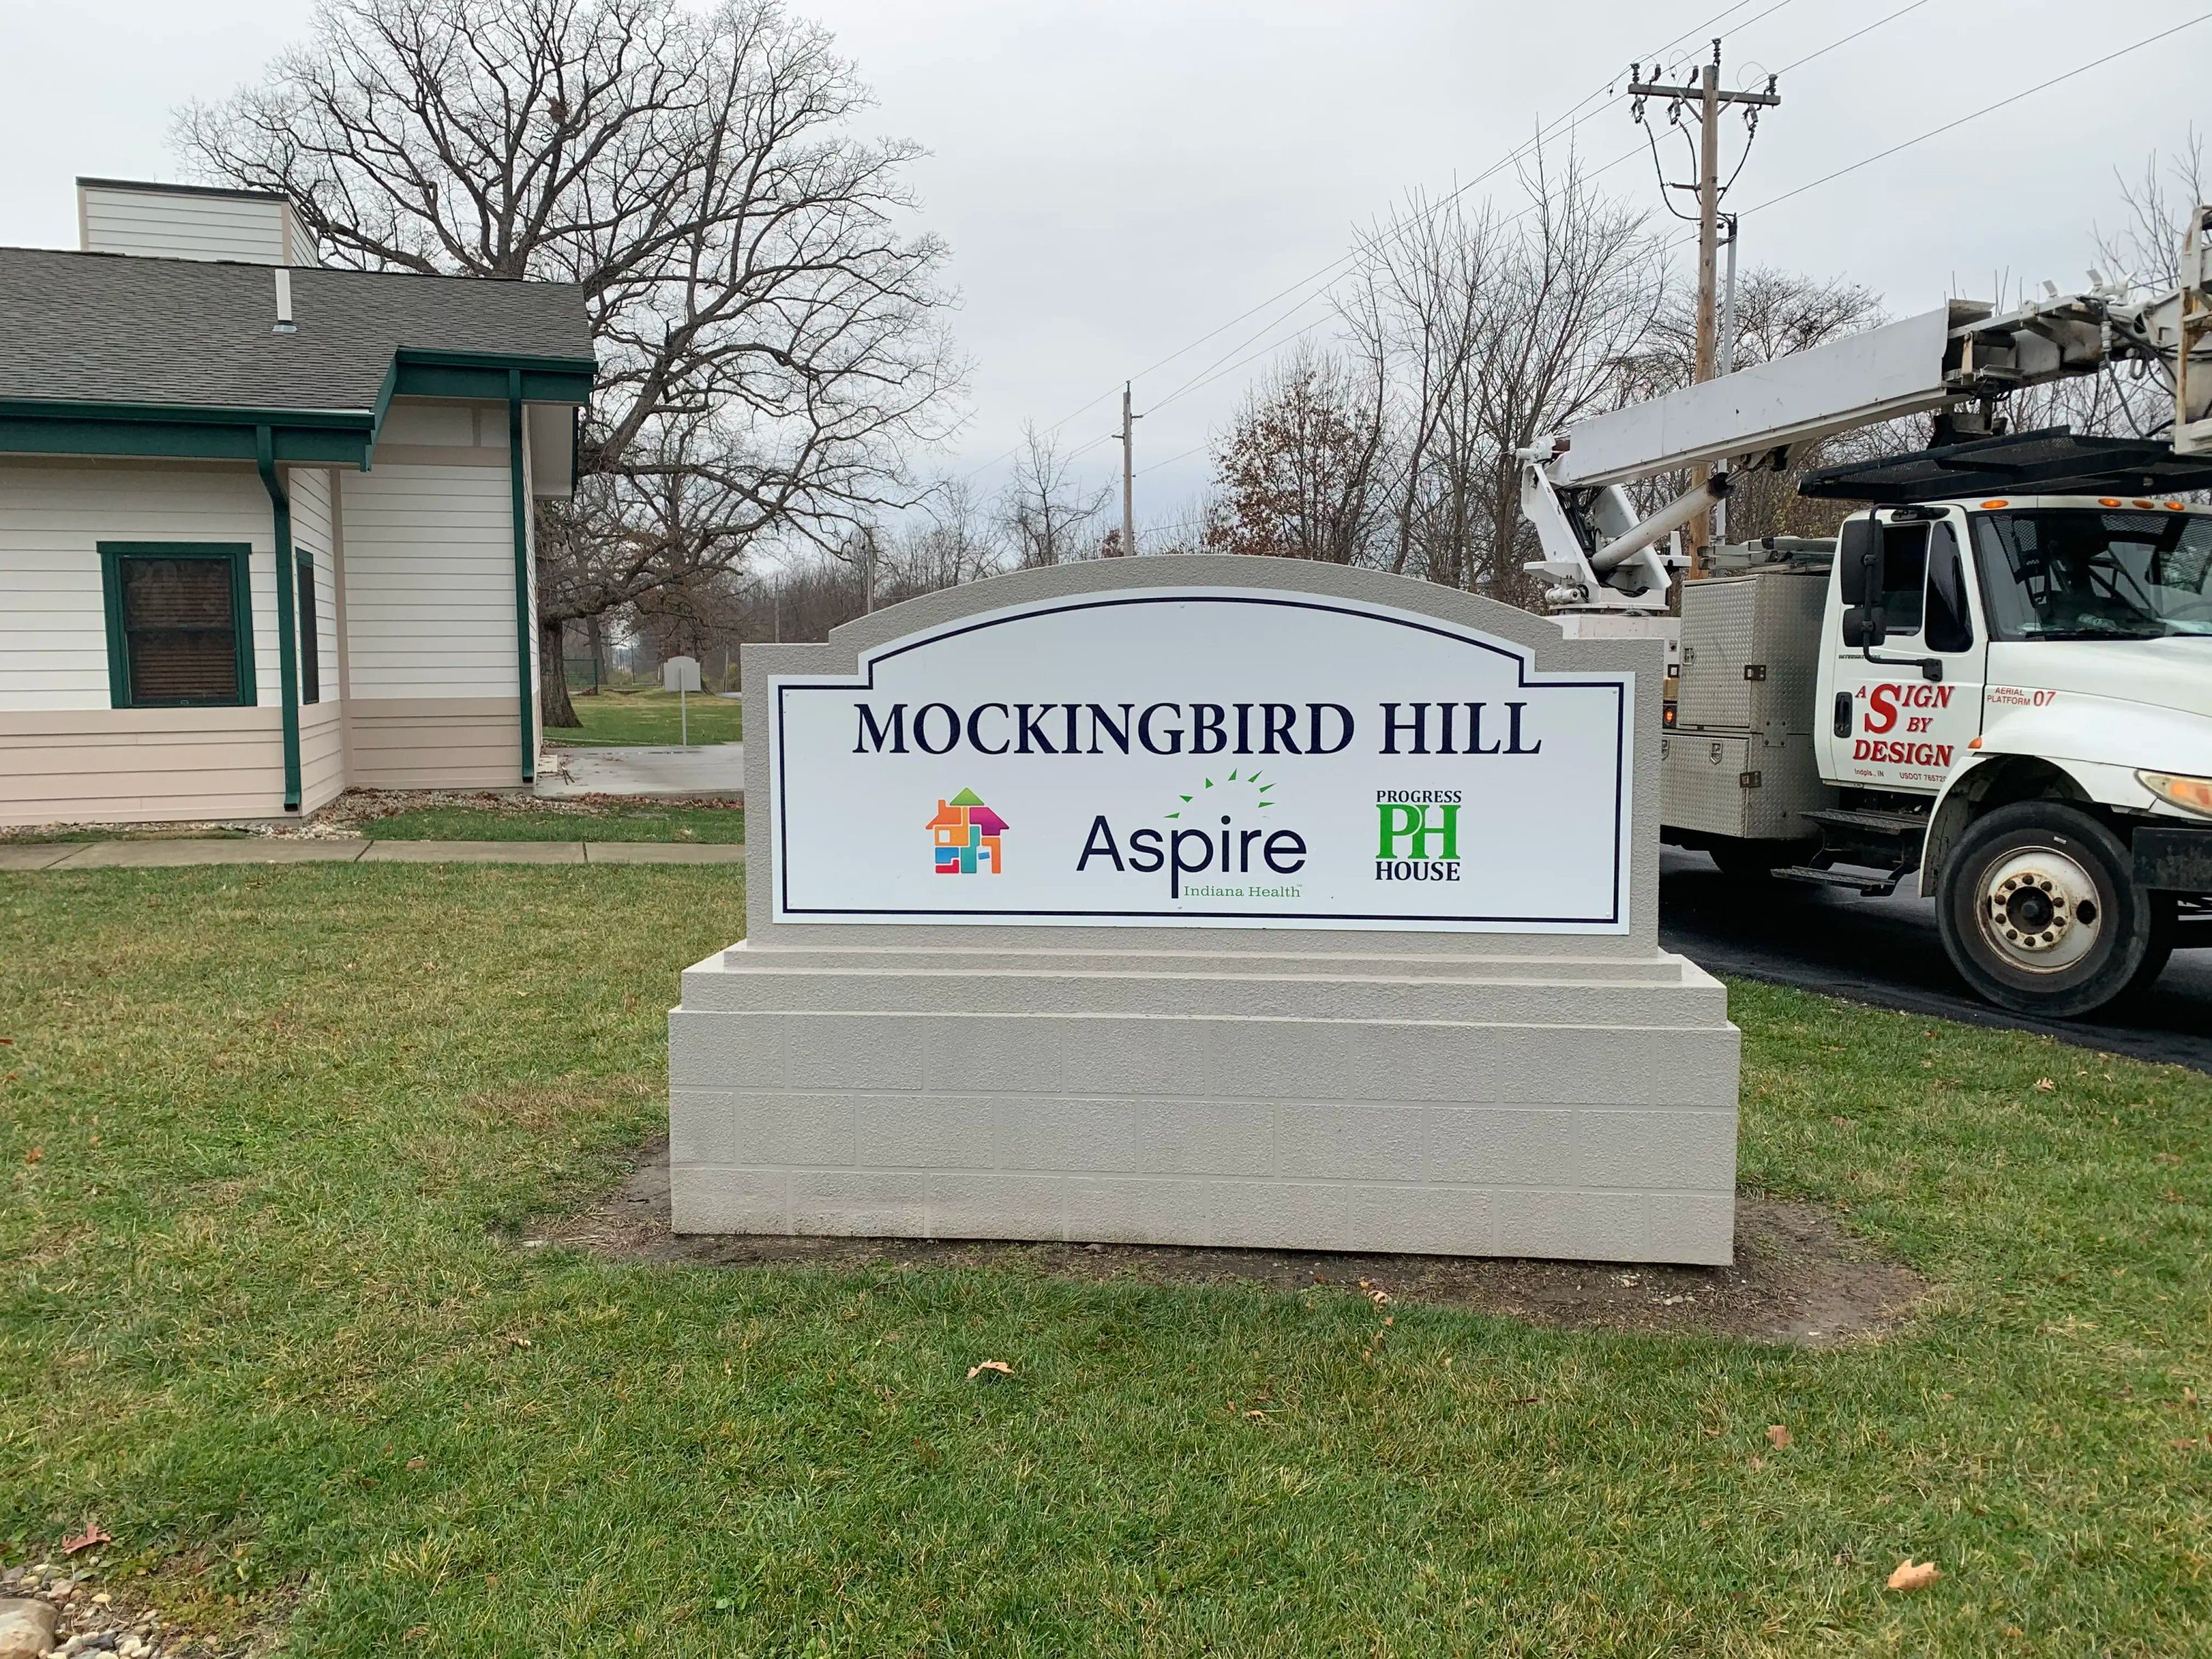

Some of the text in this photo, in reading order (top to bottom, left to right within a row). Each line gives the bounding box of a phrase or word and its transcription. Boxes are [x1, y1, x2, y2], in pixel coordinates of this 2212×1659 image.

[1995, 687, 2025, 696] AERIAL
[2034, 690, 2056, 707] 07
[1855, 684, 1955, 734] A SIGN
[1986, 695, 2031, 706] PLATFORM
[852, 702, 1543, 756] MOCKINGBIRD HILL
[1906, 717, 1934, 733] BY
[1852, 740, 1955, 768] DESIGN
[1899, 772, 1921, 781] USDOT
[1376, 790, 1462, 803] PROGRESS
[1375, 804, 1461, 860] PH
[1076, 815, 1307, 899] Aspire
[1375, 861, 1461, 881] HOUSE
[1183, 886, 1301, 897] Indiana Health
